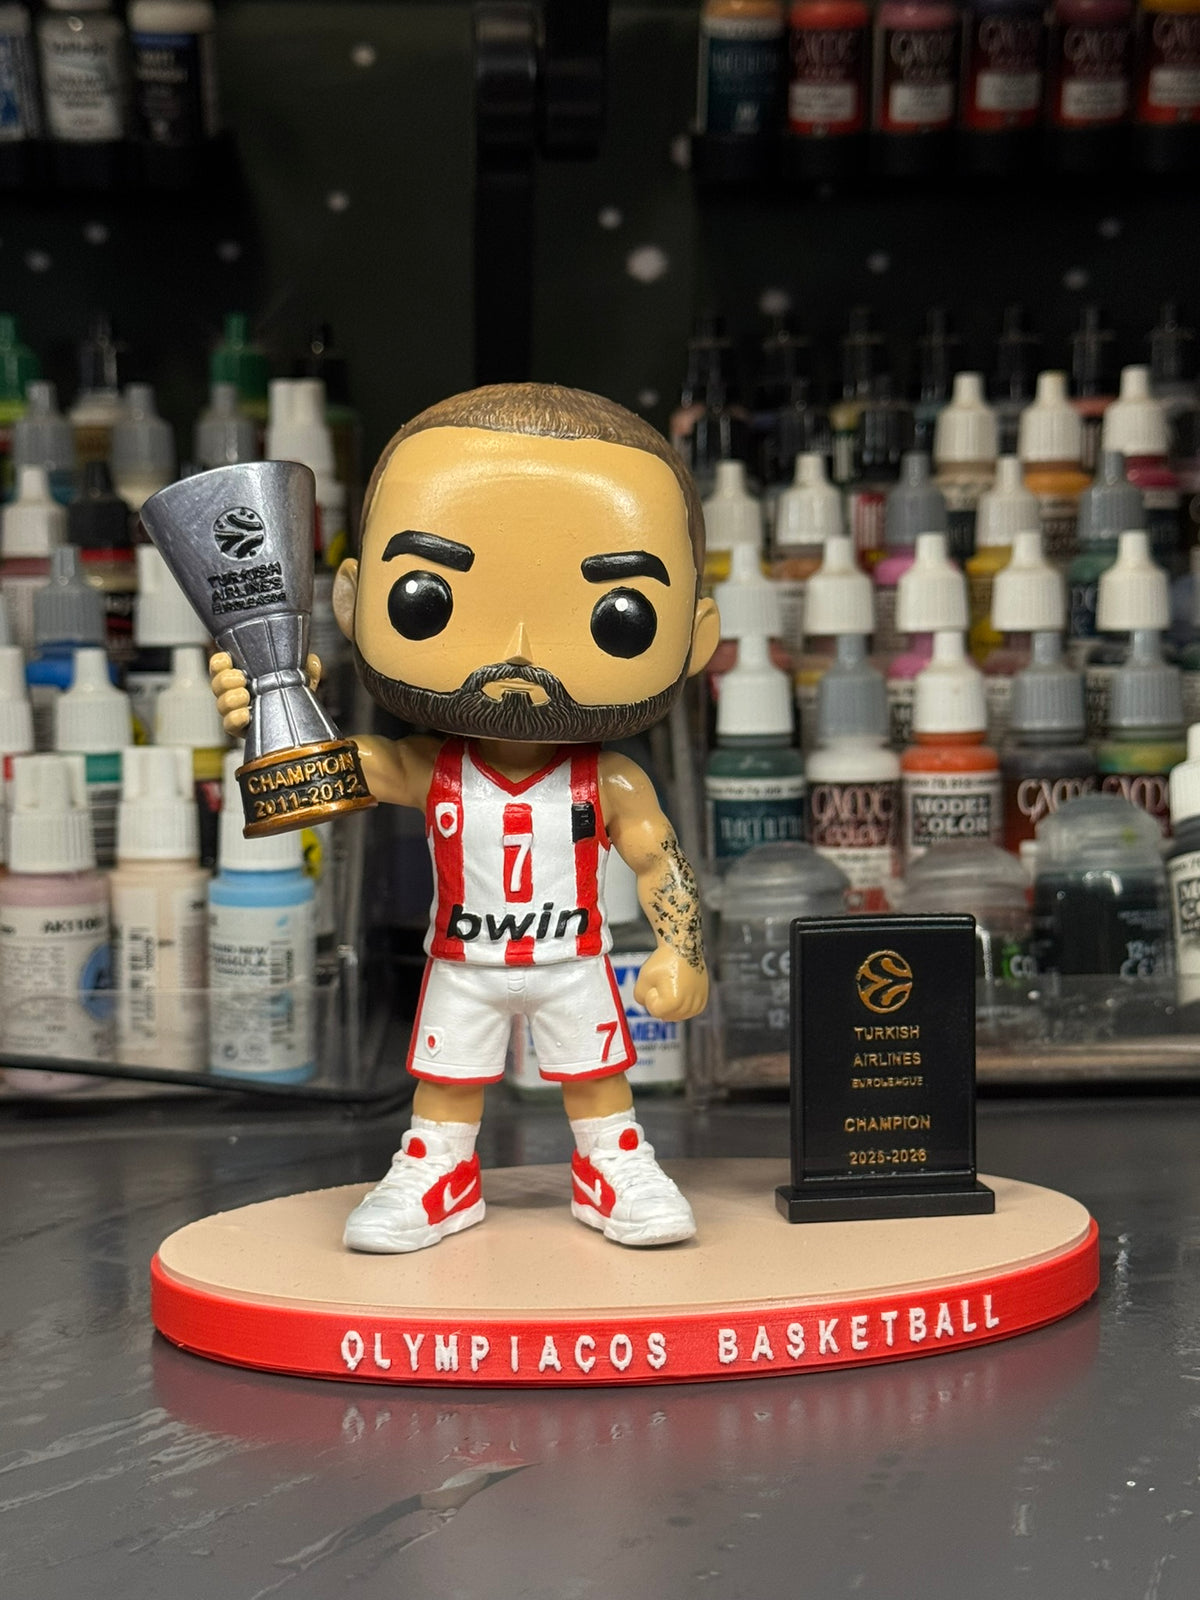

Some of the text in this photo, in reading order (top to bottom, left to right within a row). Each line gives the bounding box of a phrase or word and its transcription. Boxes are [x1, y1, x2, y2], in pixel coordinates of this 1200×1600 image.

[247, 752, 355, 795] CHAMPION
[254, 774, 363, 818] 2011-2012
[503, 833, 533, 893] 7
[447, 902, 589, 941] bwin
[596, 1021, 619, 1063] 7
[853, 1024, 921, 1041] TURKISH
[853, 1051, 922, 1068] AIRLINES
[851, 1075, 924, 1088] EUROLEAGUE
[844, 1114, 932, 1132] CHAMPION
[340, 1294, 1000, 1374] OLYMPIACOS BASKETBALL
